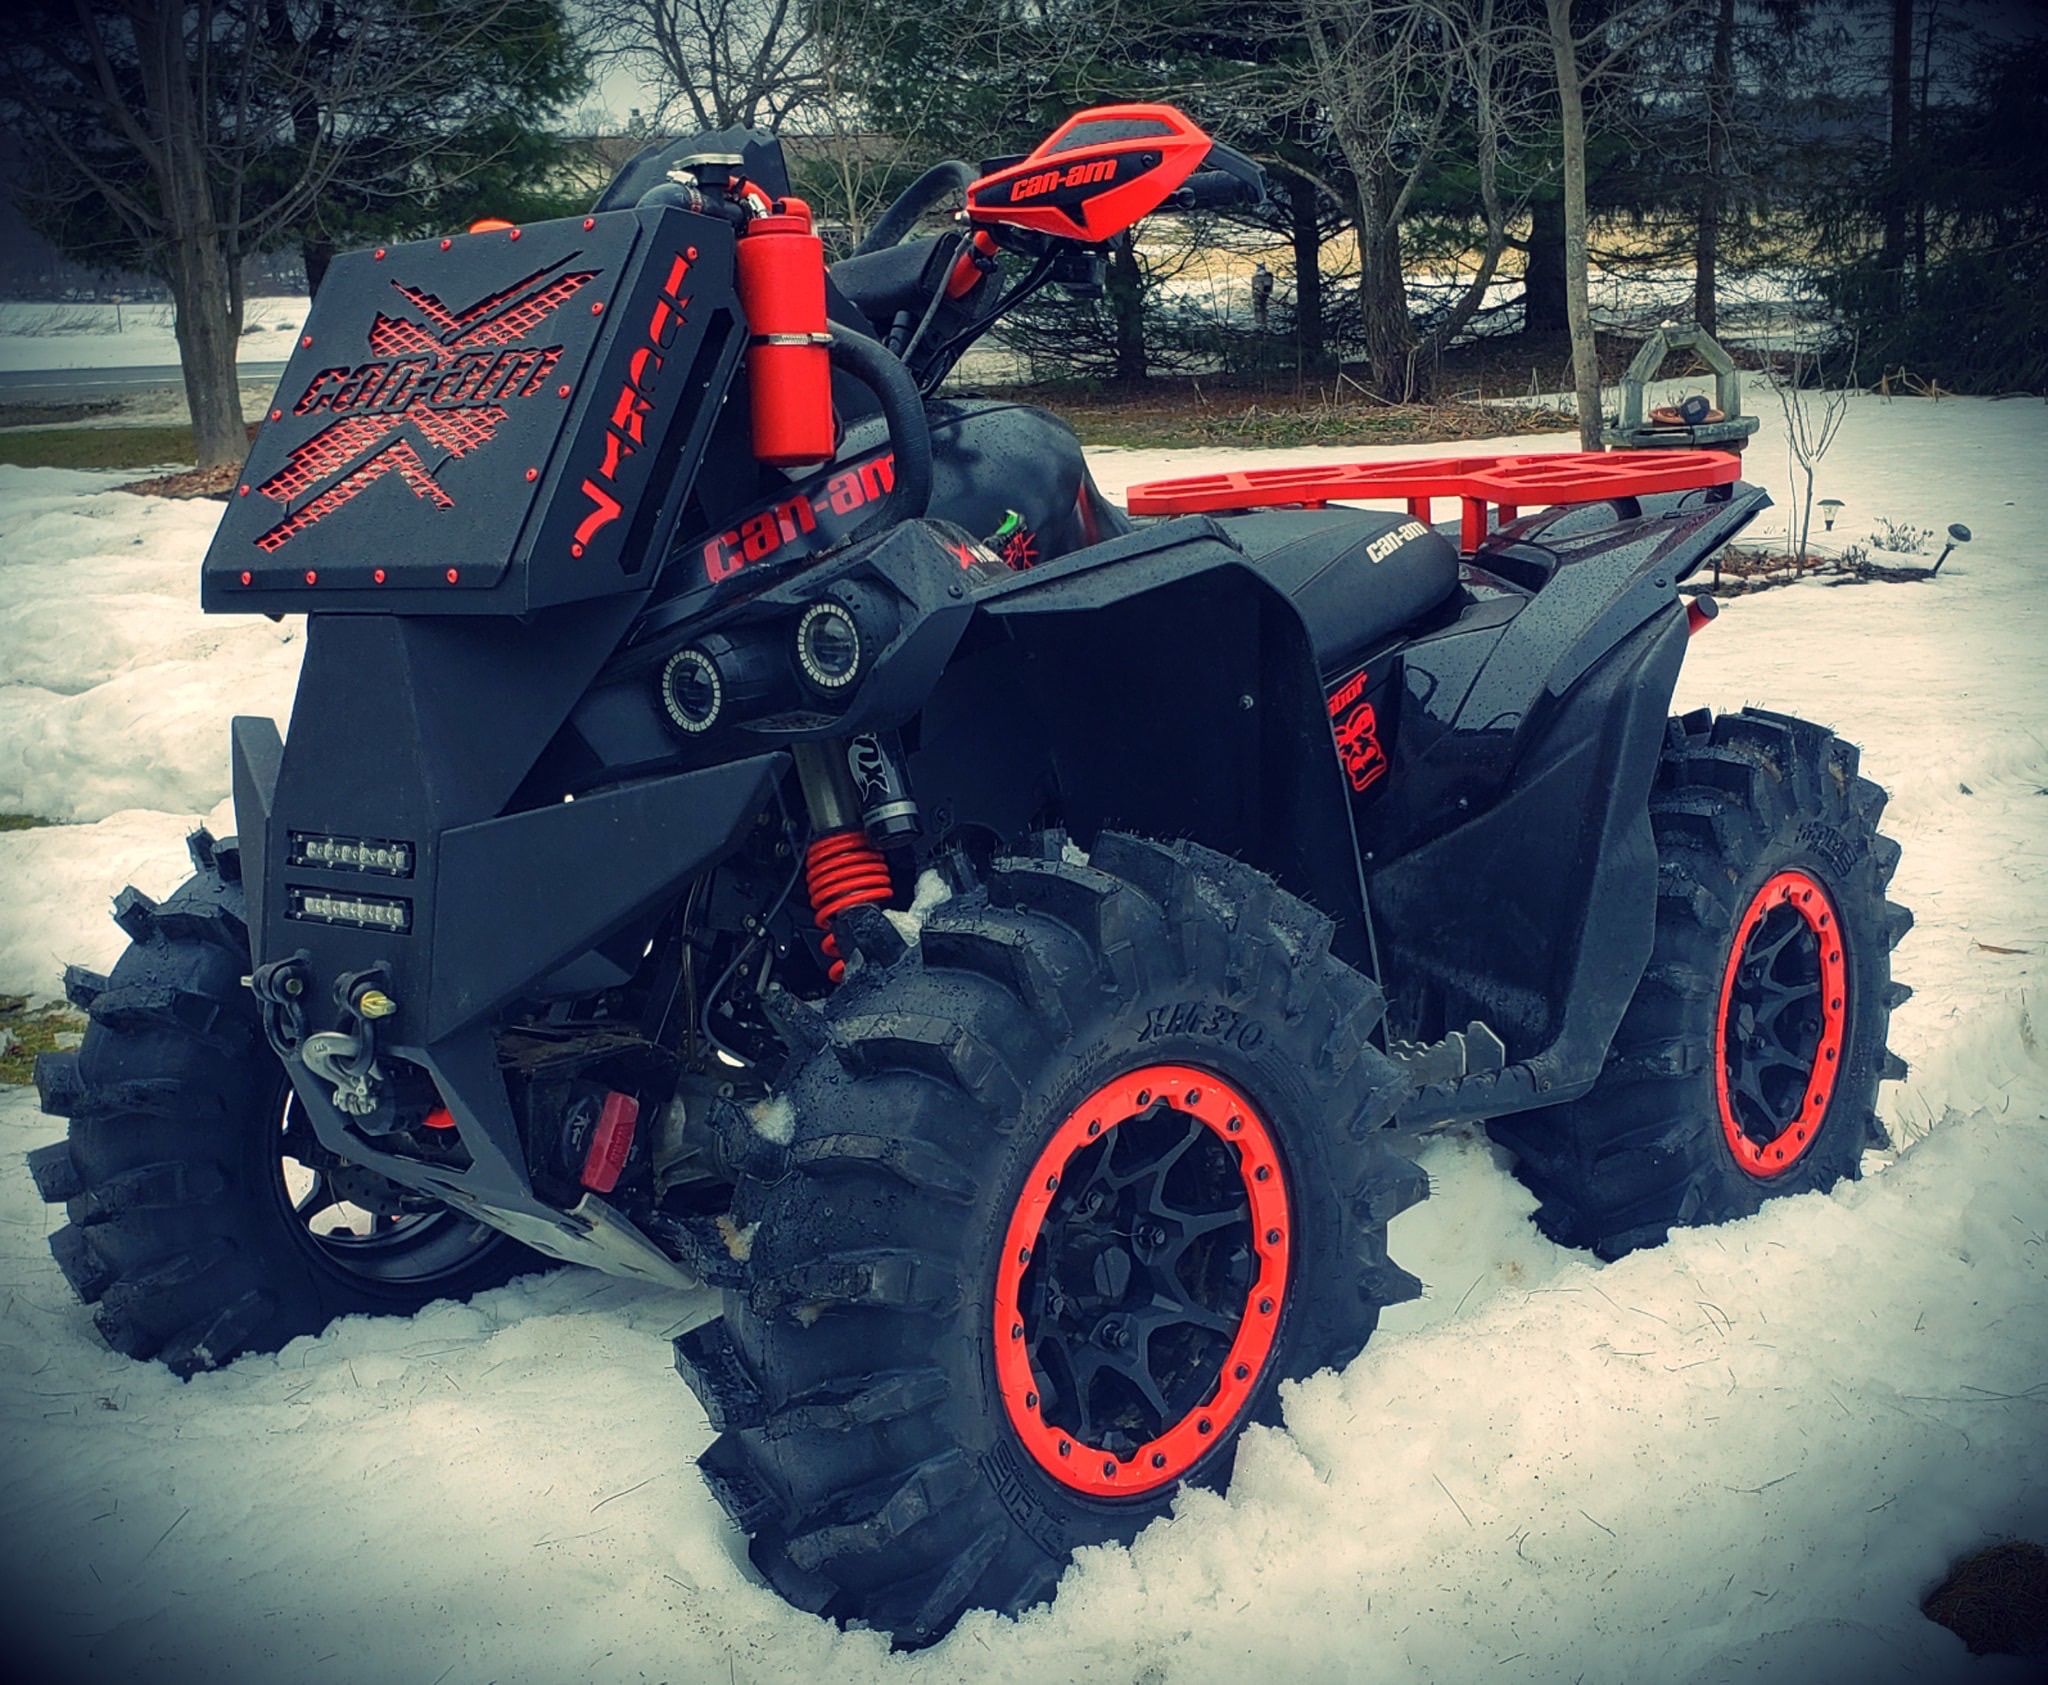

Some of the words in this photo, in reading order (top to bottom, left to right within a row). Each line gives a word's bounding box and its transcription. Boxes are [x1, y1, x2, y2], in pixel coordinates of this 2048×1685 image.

[1010, 159, 1098, 202] can-am
[292, 343, 565, 417] can-am
[597, 251, 693, 482] LUCKY
[573, 478, 624, 546] 7
[703, 452, 895, 584] can-am
[1366, 520, 1429, 564] can-am
